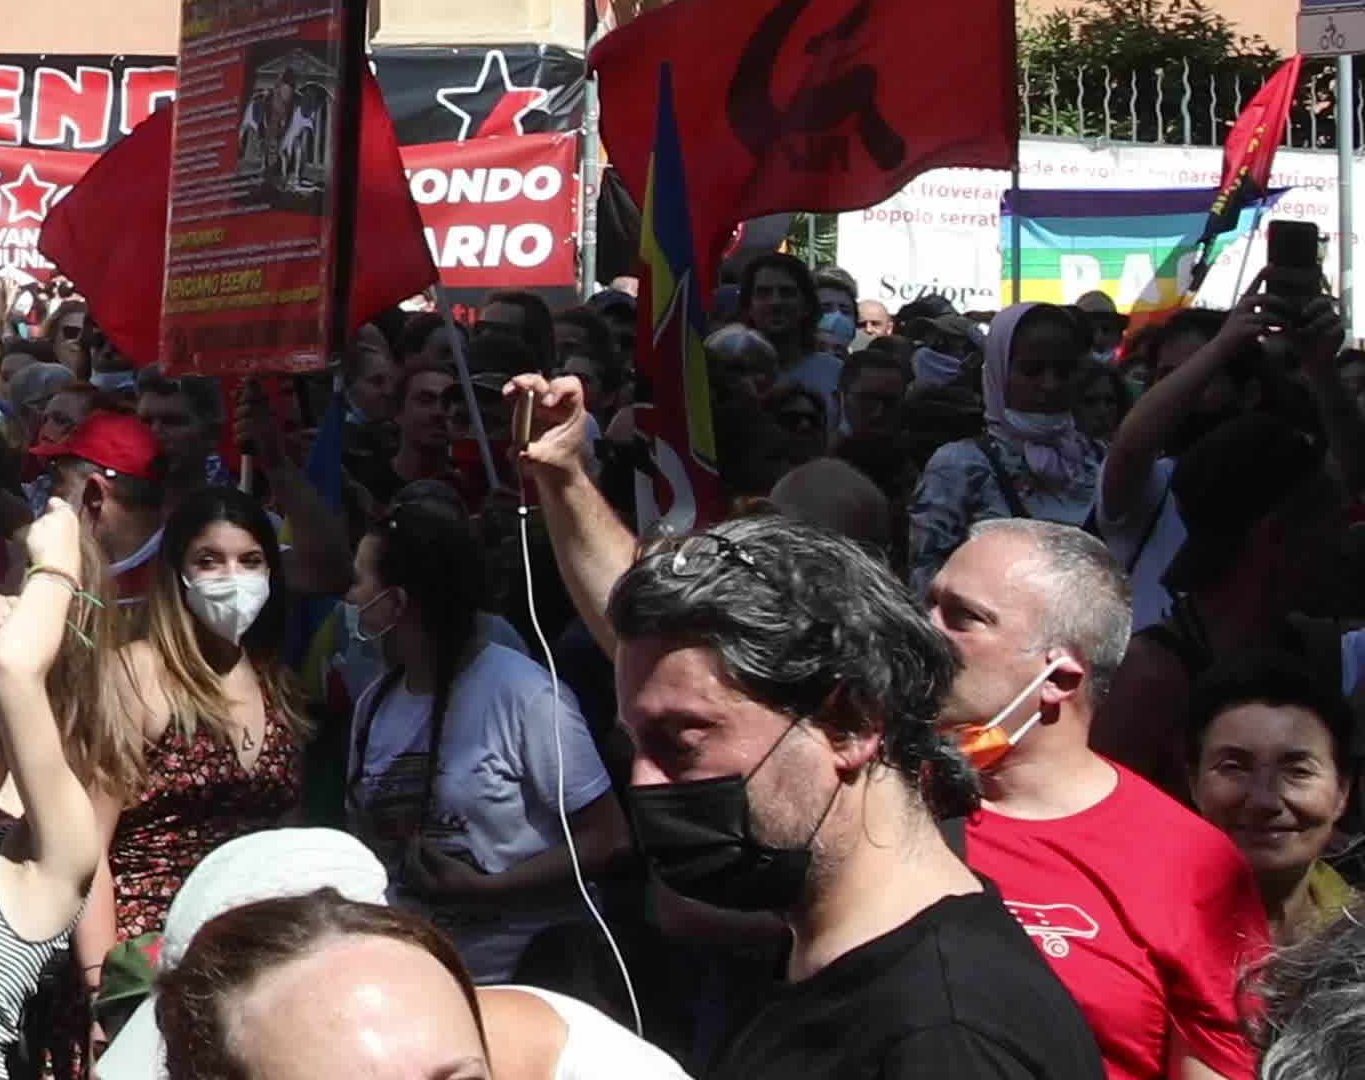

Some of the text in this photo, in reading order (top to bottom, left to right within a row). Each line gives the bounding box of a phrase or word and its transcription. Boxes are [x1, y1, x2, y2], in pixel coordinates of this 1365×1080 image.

[405, 165, 562, 205] ONDO
[863, 203, 1000, 228] popolo serrat
